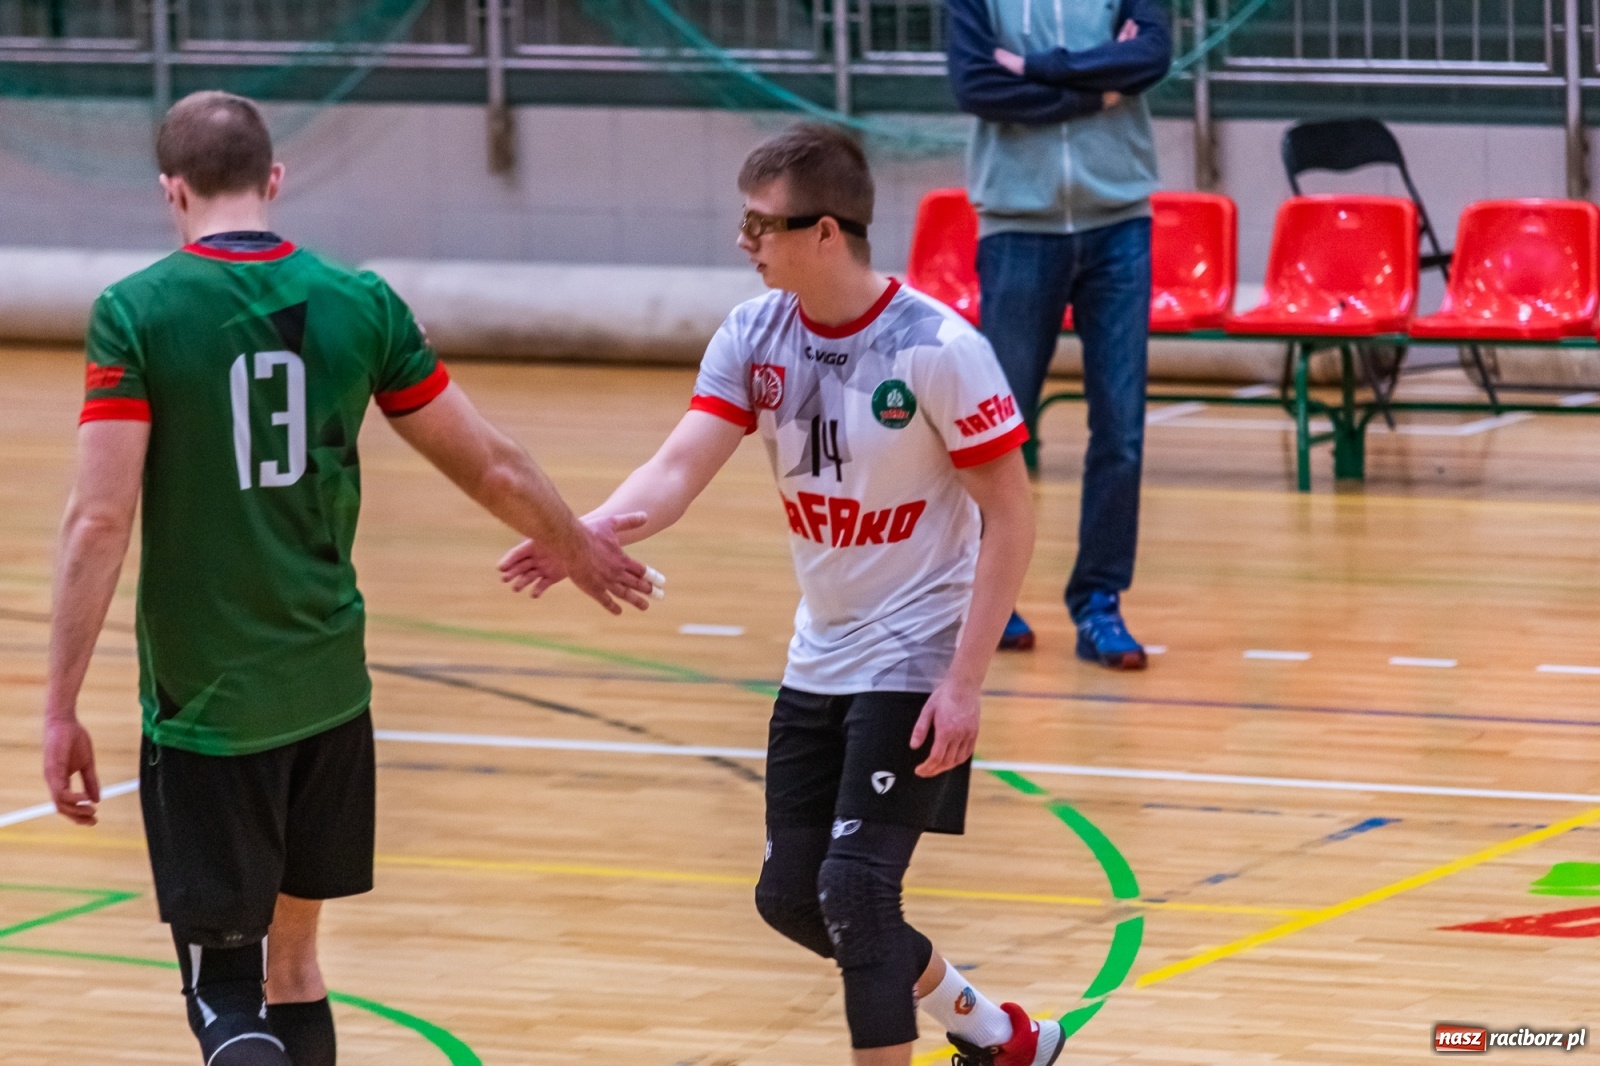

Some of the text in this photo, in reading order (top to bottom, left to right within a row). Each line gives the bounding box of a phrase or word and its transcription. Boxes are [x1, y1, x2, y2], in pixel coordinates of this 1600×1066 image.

[229, 350, 307, 491] 13
[811, 414, 843, 483] 14
[779, 488, 927, 549] AFAKO
